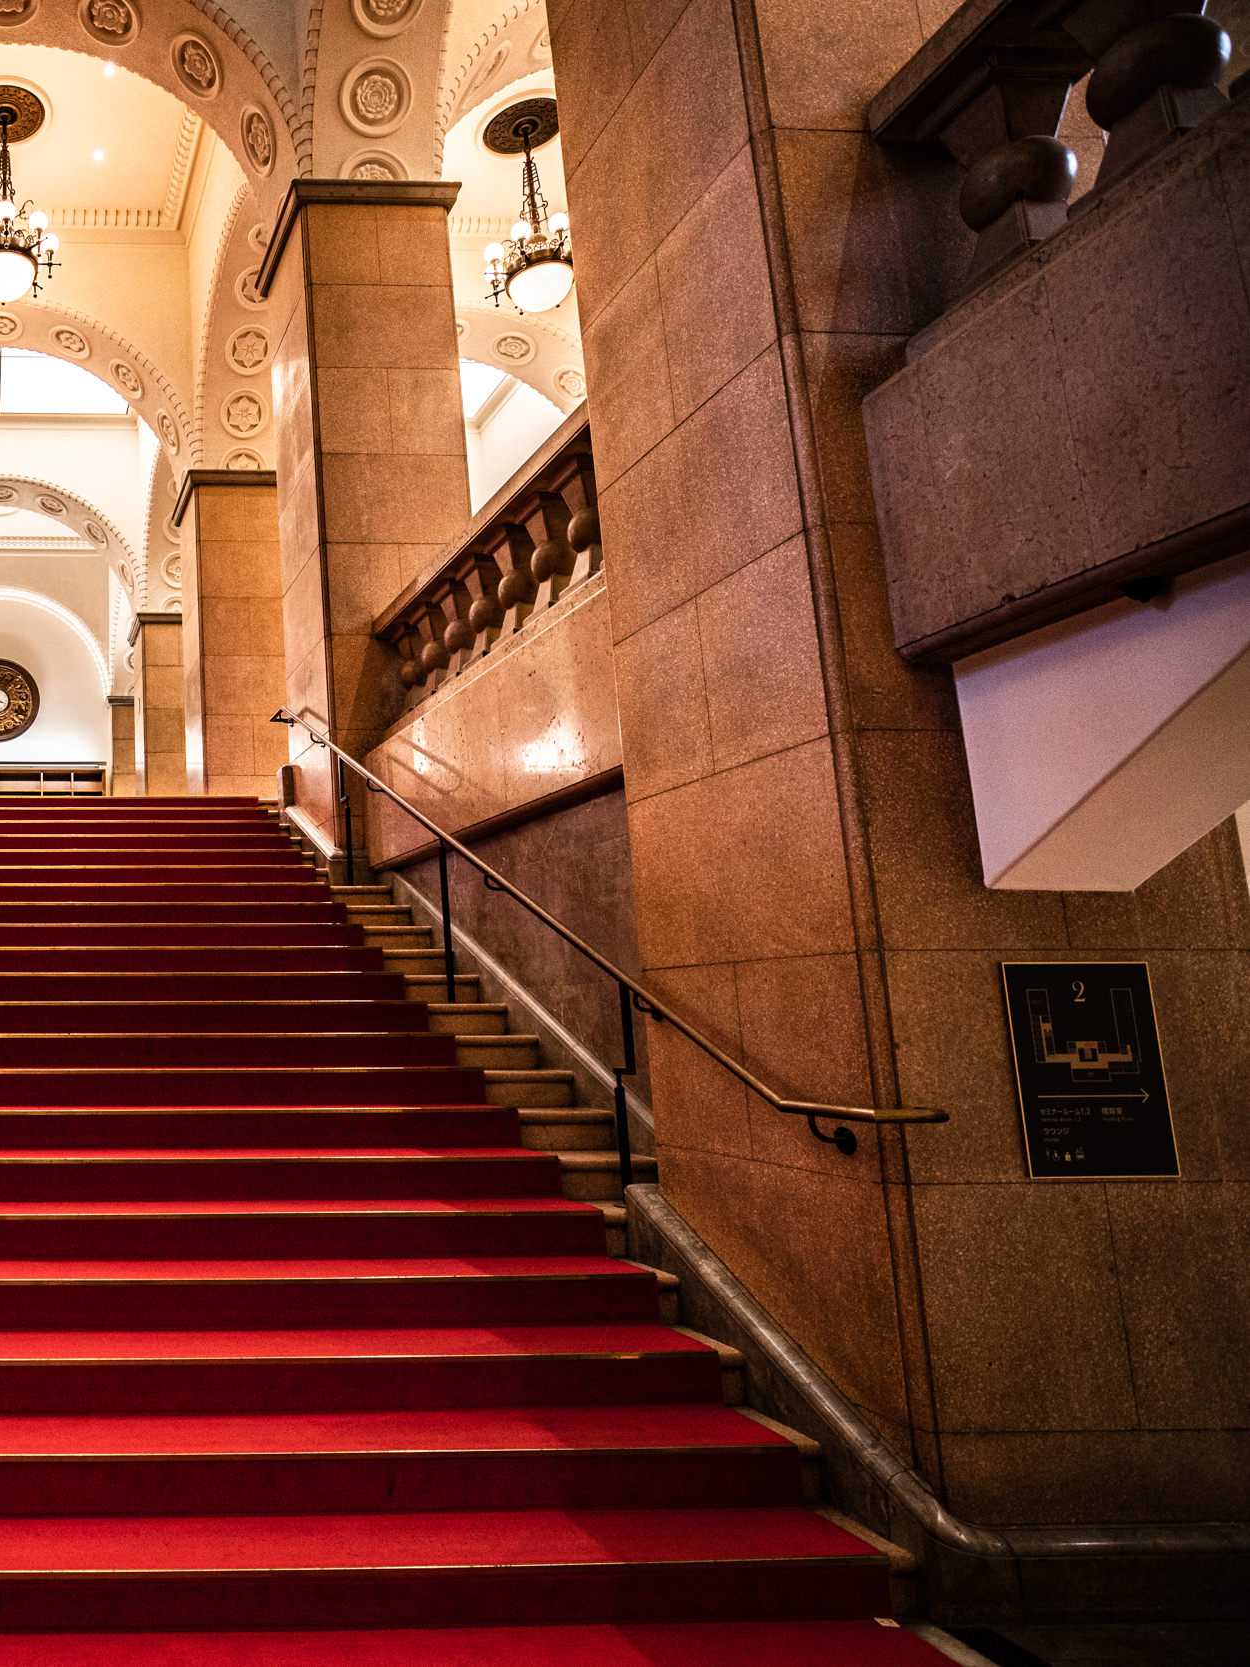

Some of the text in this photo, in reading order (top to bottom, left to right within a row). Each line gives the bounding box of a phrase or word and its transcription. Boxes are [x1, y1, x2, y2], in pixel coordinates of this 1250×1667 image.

[1071, 980, 1086, 1003] 2
[1043, 1127, 1070, 1136] ラウンジ
